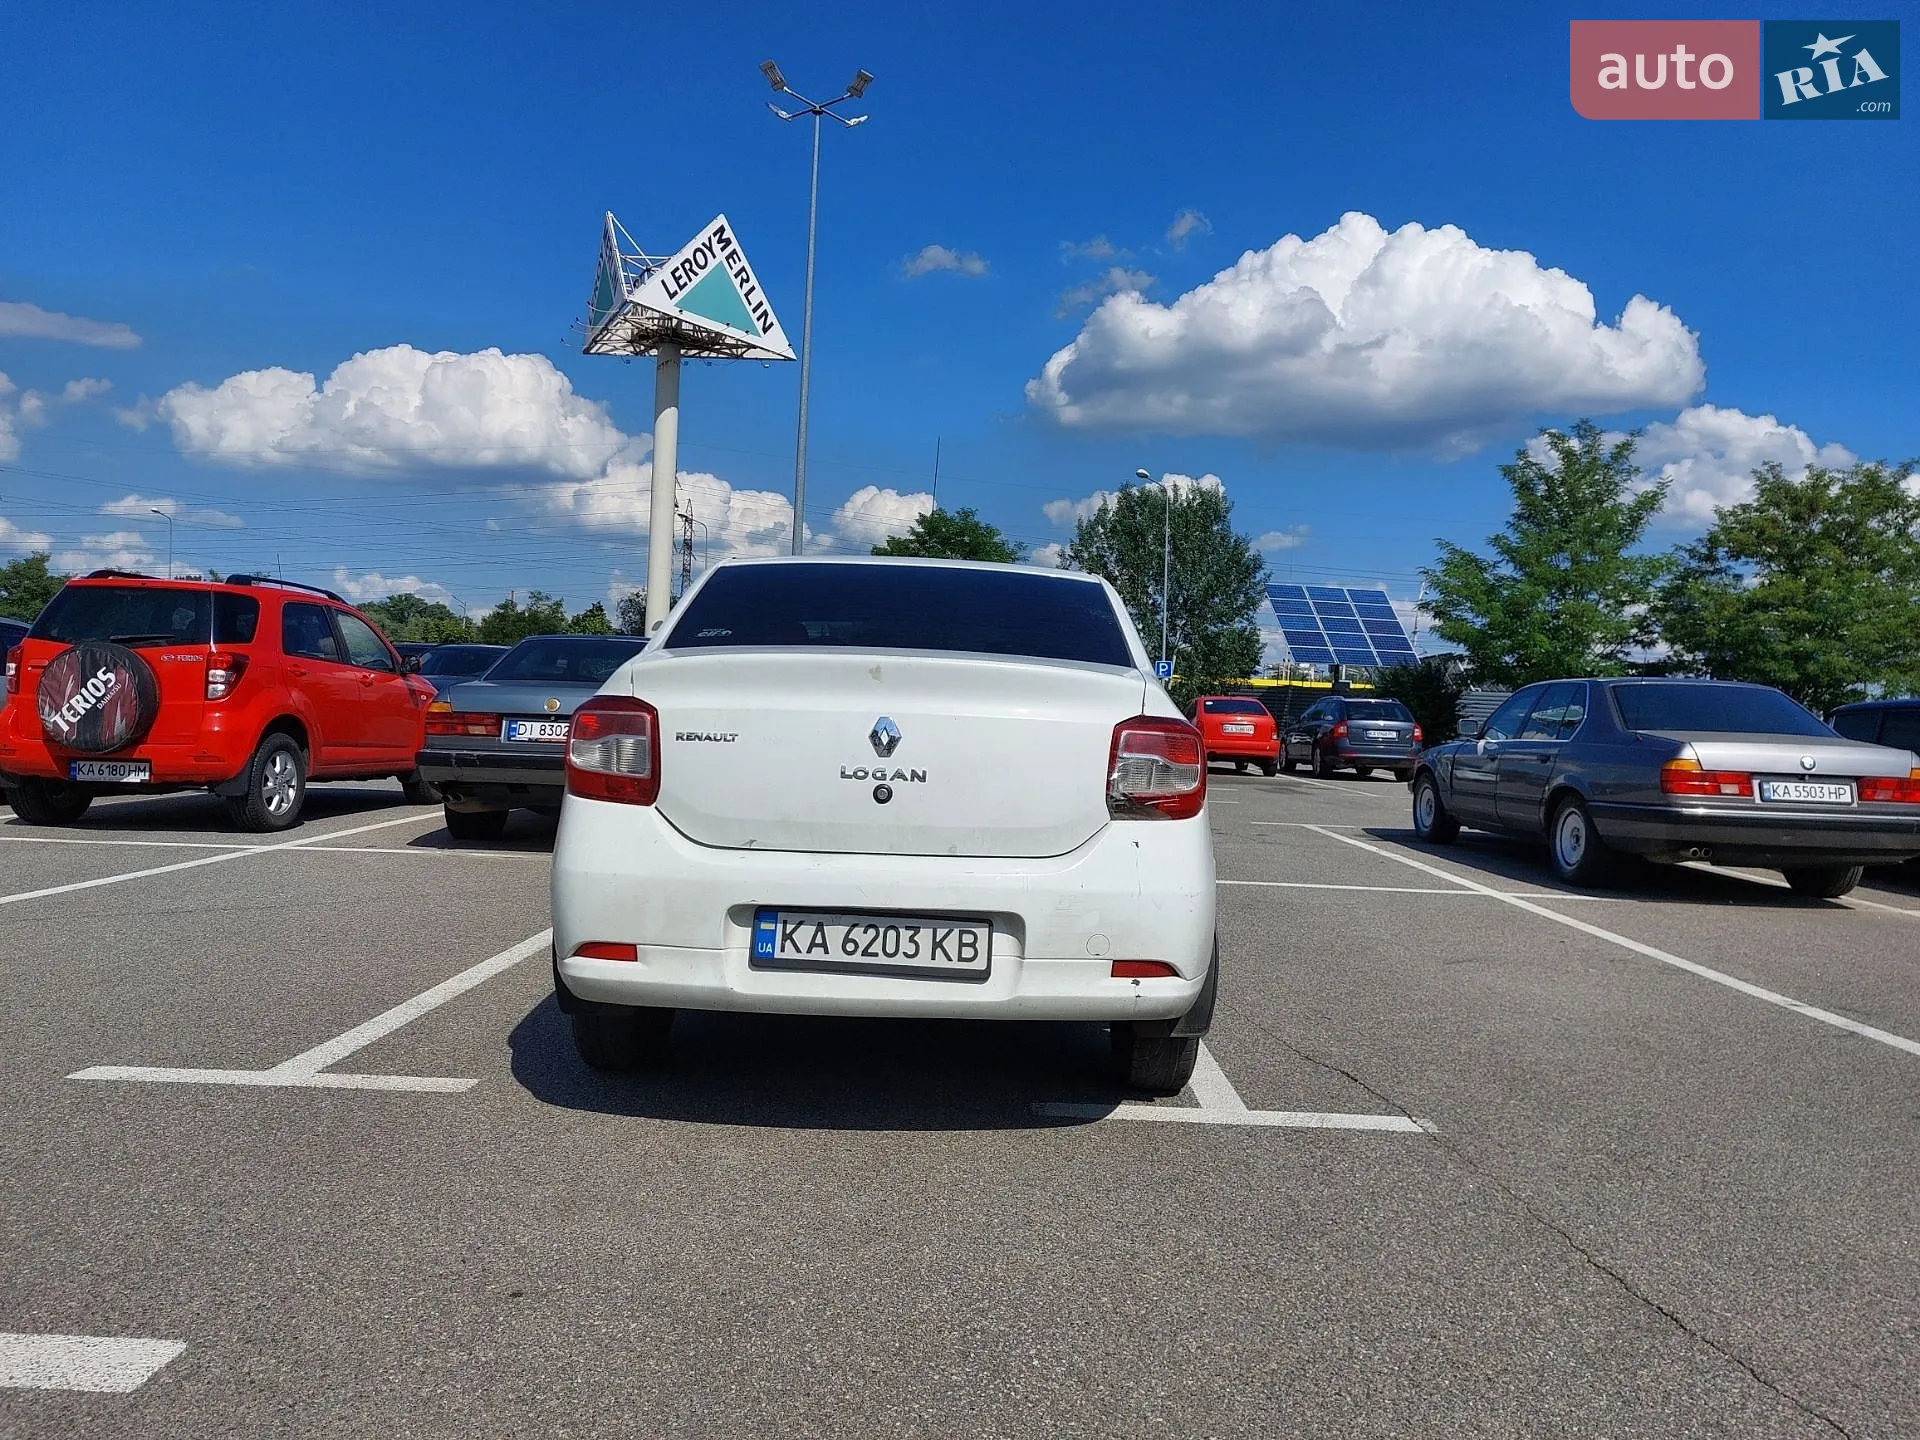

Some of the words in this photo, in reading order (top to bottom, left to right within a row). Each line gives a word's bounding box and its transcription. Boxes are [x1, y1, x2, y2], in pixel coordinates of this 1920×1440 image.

[660, 235, 718, 301] LEROY
[712, 223, 775, 336] MERLIN
[1159, 663, 1169, 676] P
[50, 666, 116, 732] TERIOS
[518, 723, 534, 736] DI
[539, 724, 570, 737] 8302
[675, 732, 739, 743] RENAULT
[77, 763, 95, 776] KA
[98, 764, 126, 777] 6180
[127, 765, 147, 777] HM
[840, 765, 928, 783] LOGAN
[1771, 784, 1792, 798] KA
[1794, 785, 1826, 799] 5503
[1827, 786, 1848, 800] HP
[758, 942, 773, 953] UA
[779, 919, 830, 955] KA
[840, 922, 922, 959] 6203
[930, 927, 980, 963] KB
